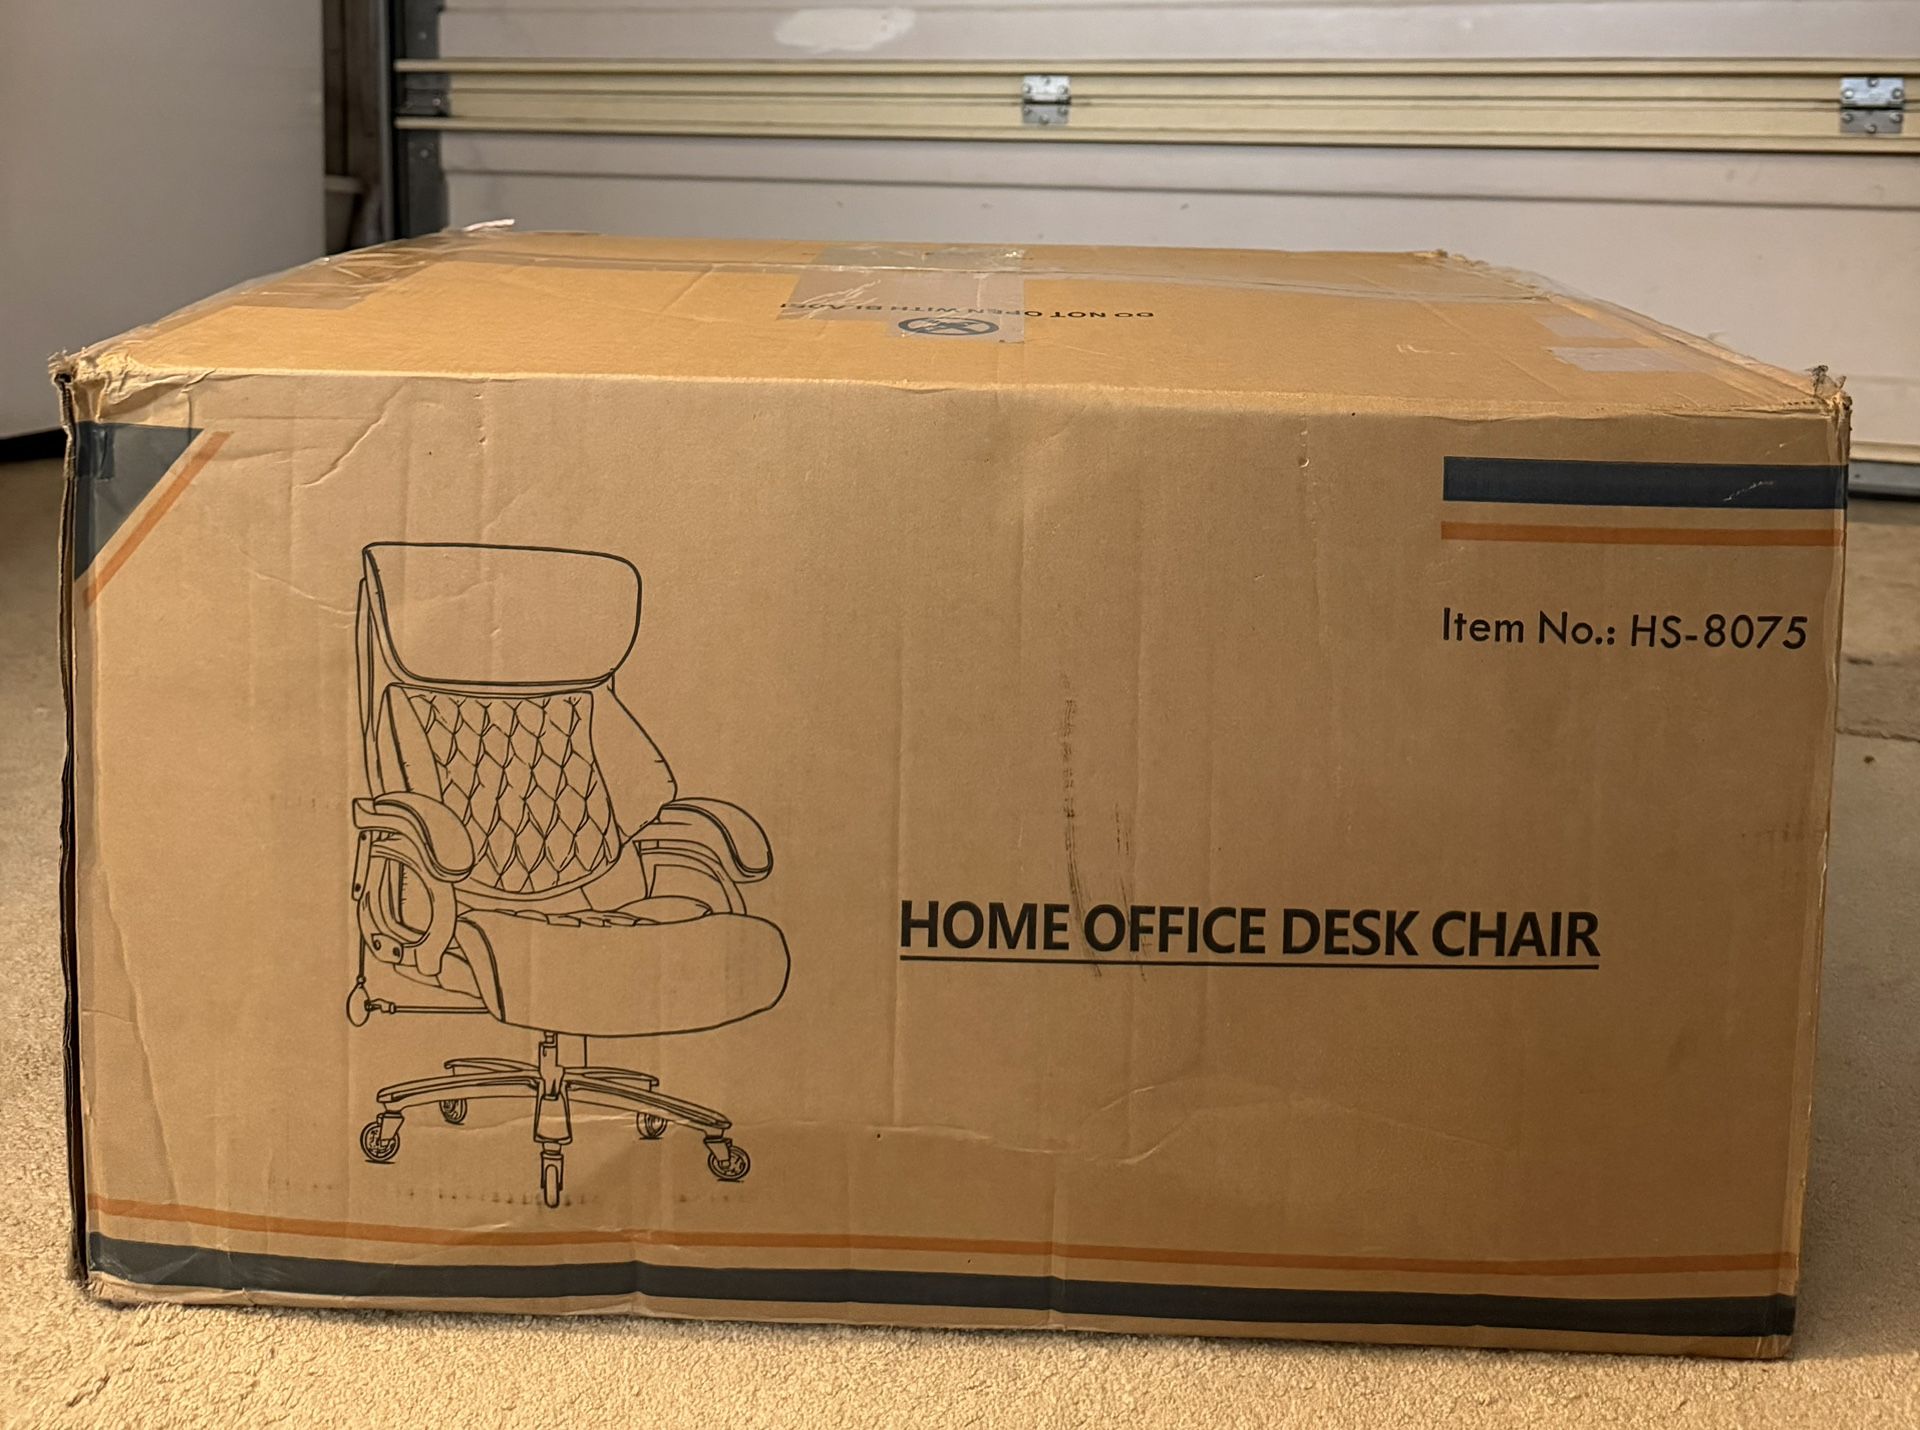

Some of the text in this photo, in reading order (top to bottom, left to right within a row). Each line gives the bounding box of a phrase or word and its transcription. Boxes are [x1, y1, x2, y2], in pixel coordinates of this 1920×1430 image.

[891, 305, 960, 313] WITH
[967, 308, 1043, 317] OPEN
[1442, 607, 1809, 650] Item No.: HS-8075
[900, 900, 1601, 958] HOME OFFICE DESK CHAIR
